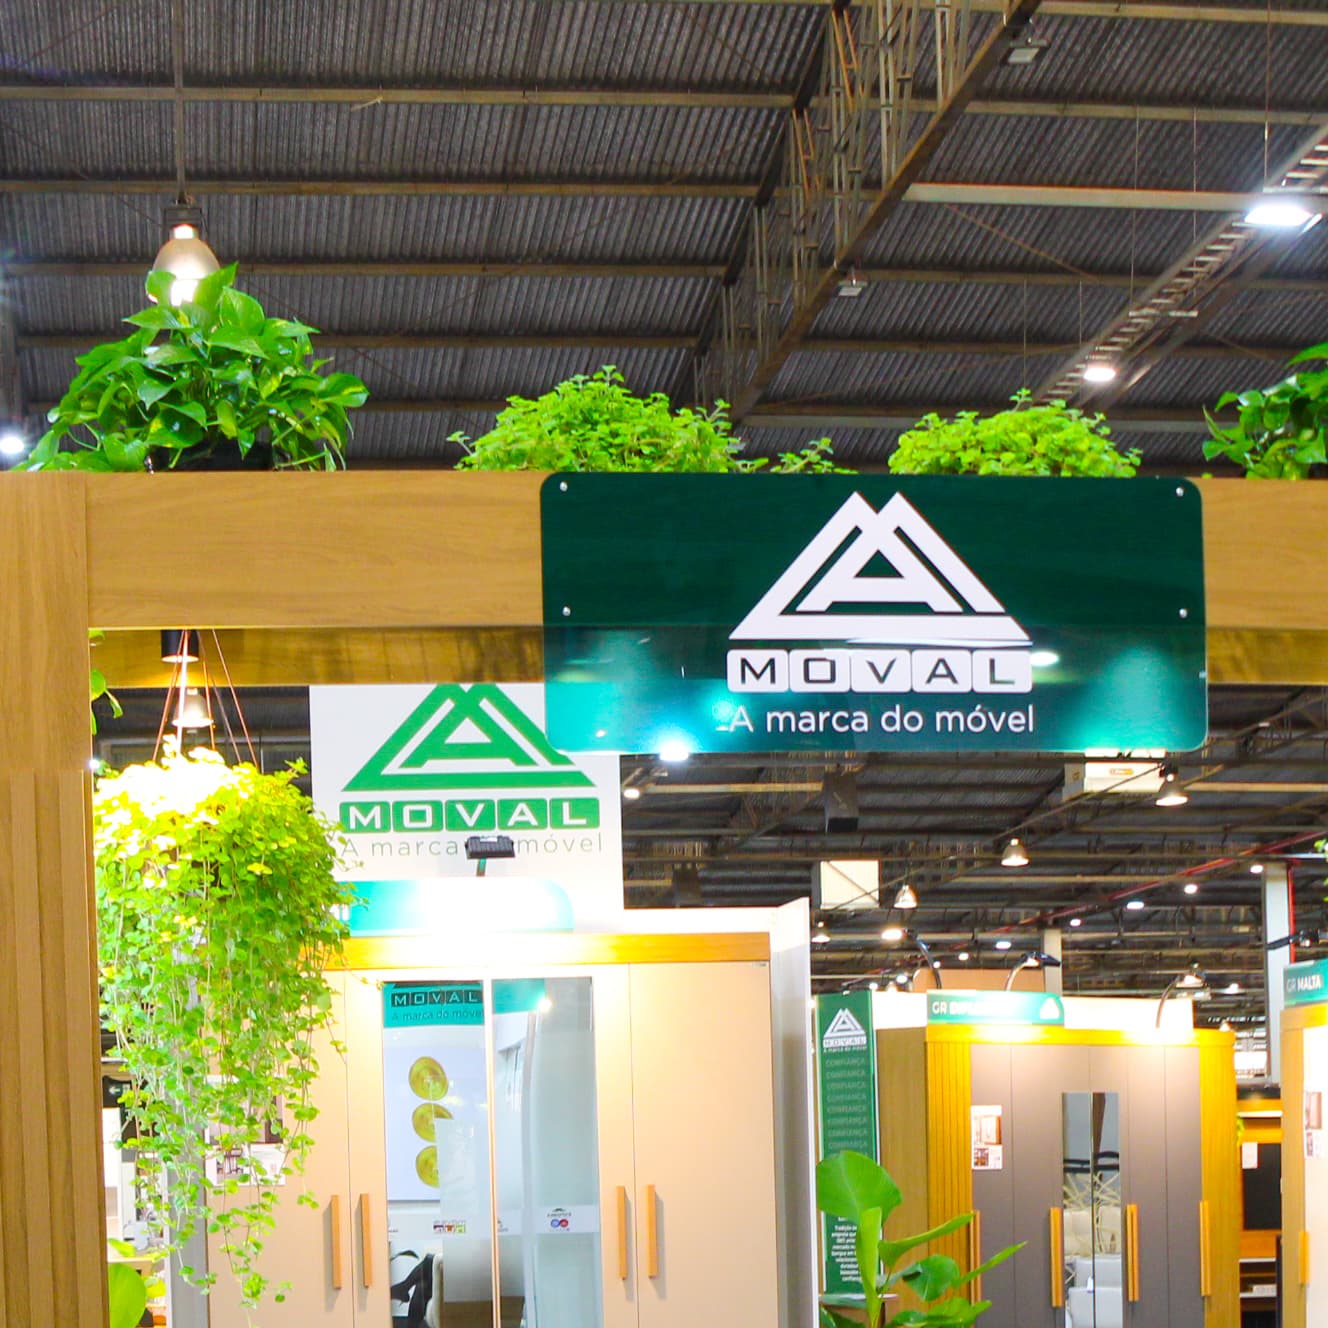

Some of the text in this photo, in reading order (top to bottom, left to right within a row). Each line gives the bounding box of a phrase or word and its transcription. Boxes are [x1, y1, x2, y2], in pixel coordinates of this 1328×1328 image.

[738, 655, 1018, 687] MOVAL
[729, 704, 1034, 733] A marca do móvel
[346, 800, 591, 830] MOVAL
[341, 832, 602, 857] A marca móvel
[393, 991, 479, 1006] MOVAL
